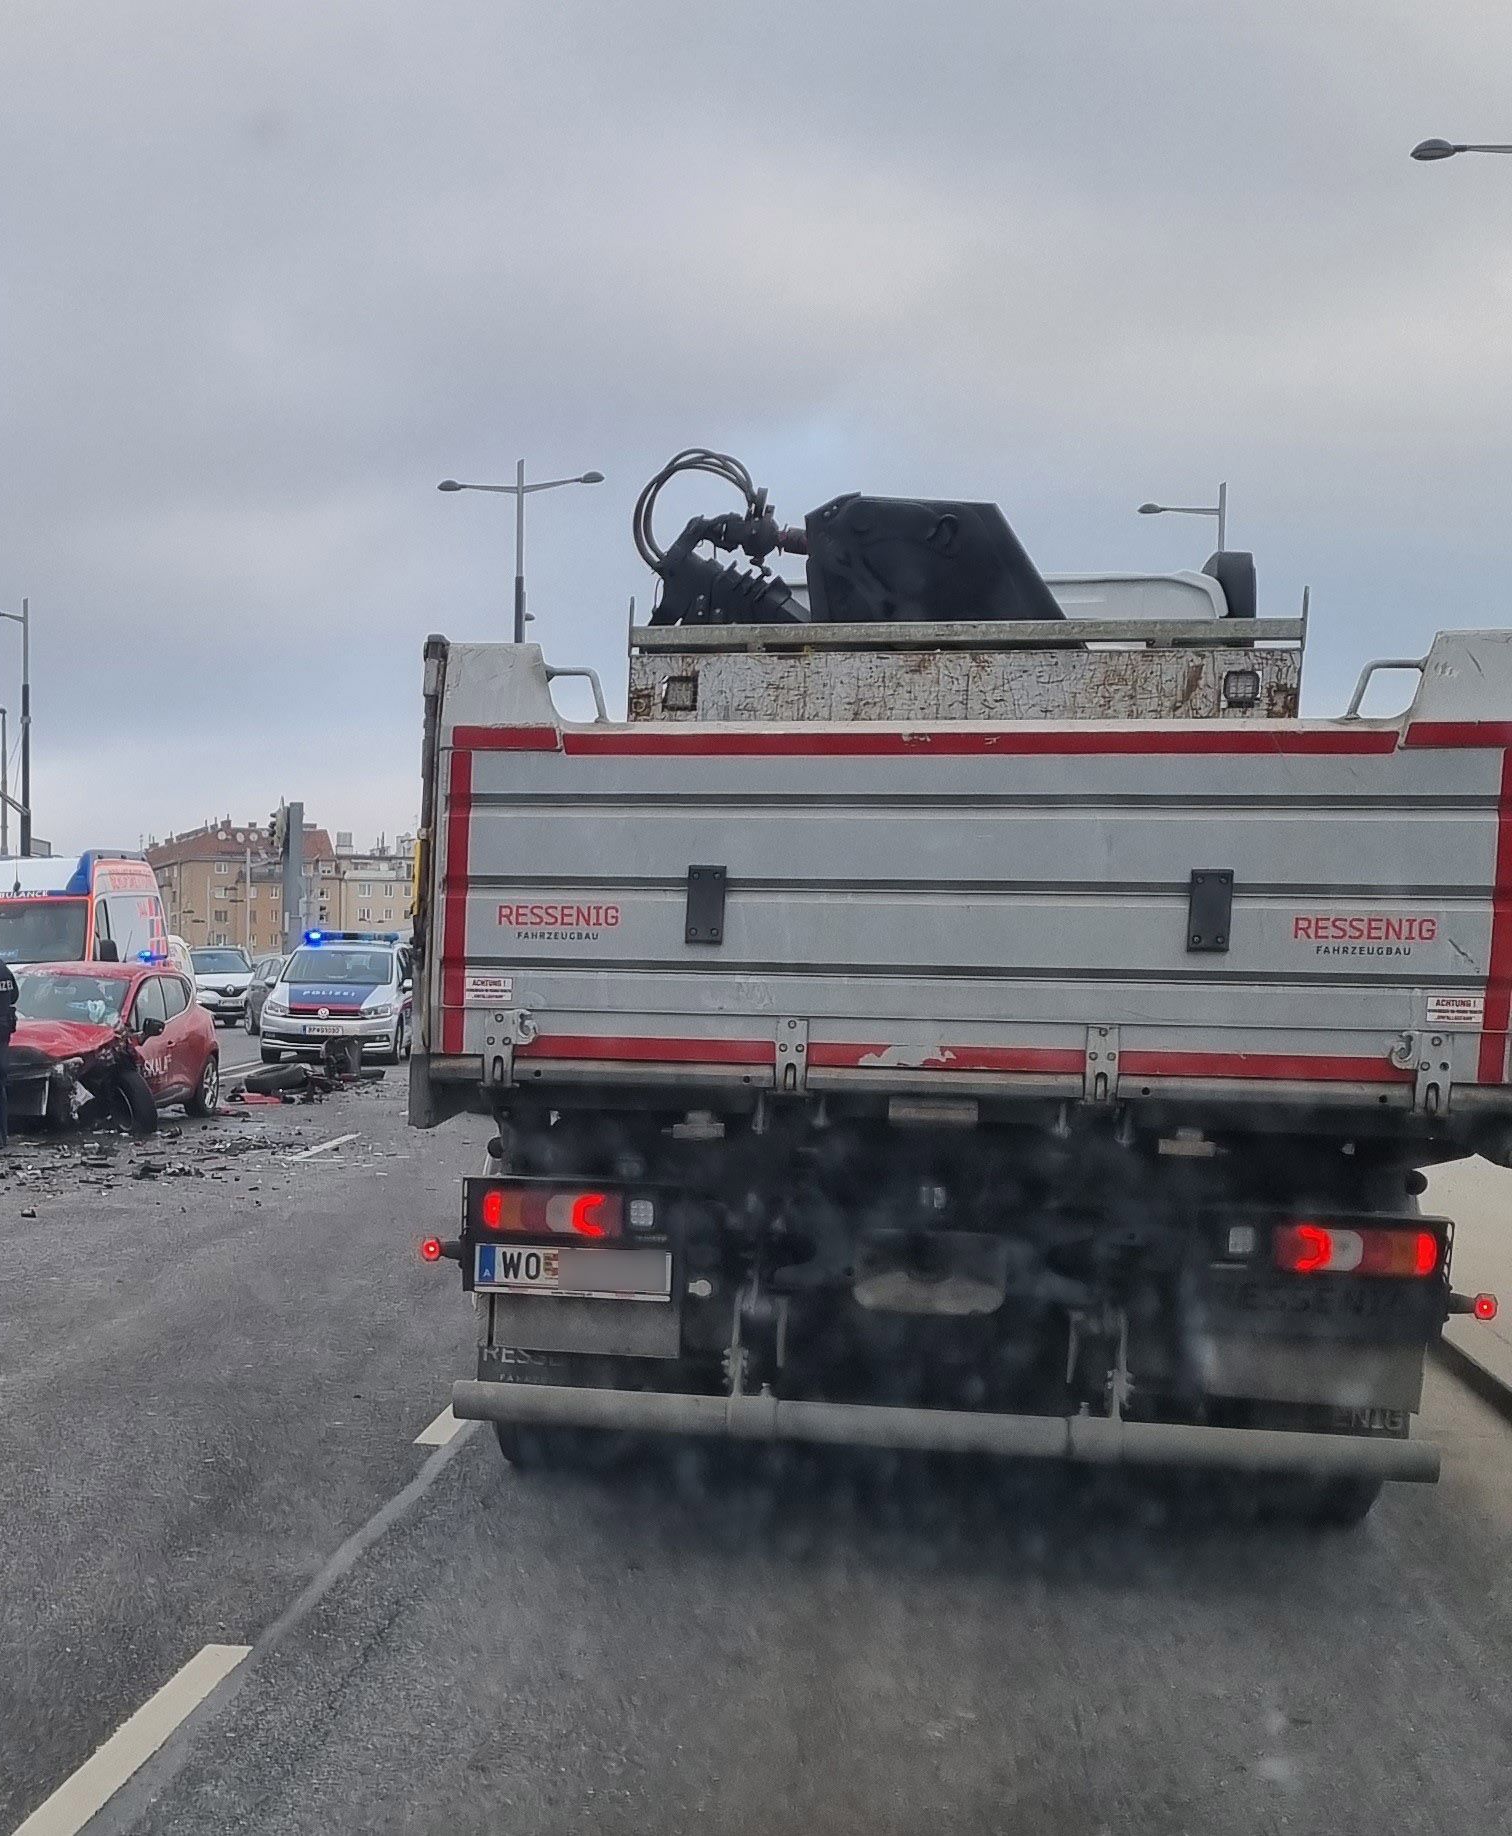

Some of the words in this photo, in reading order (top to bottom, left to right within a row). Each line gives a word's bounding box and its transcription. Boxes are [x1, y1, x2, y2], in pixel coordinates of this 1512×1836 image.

[498, 904, 620, 927] RESSENIG
[1293, 917, 1437, 941] RESSENIG
[517, 931, 599, 940] FAHRZEUGBAU
[1316, 945, 1412, 956] FAHRZEUGBAU
[302, 989, 356, 997] POLIZEI
[1435, 999, 1472, 1008] ACHTUNG
[501, 1250, 541, 1281] WO
